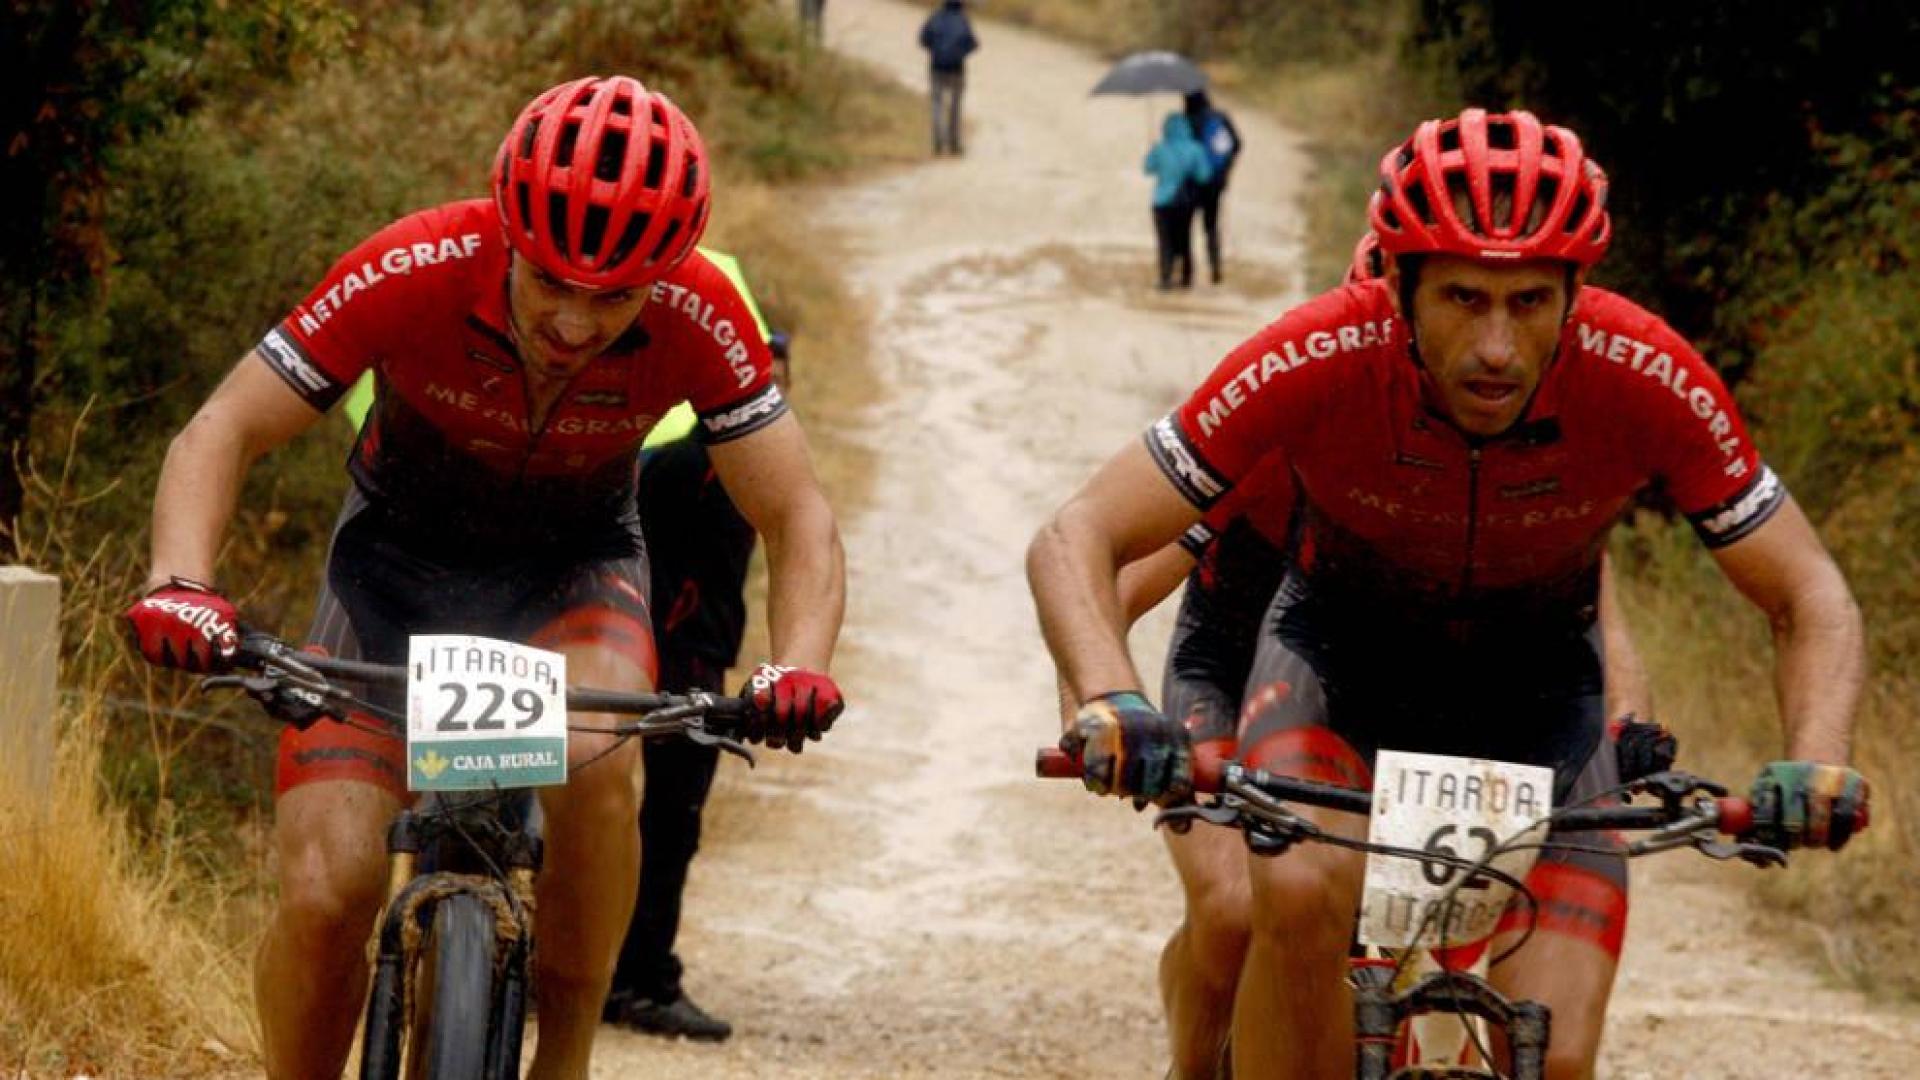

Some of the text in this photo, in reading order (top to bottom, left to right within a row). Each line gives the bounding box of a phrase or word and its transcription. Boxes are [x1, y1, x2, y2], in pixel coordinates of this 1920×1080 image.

[299, 233, 481, 336] METALGRAF
[651, 280, 757, 388] ETALGRA
[1197, 317, 1392, 438] METALGRAF
[430, 647, 551, 685] ITAROA
[437, 682, 544, 731] 229
[454, 752, 558, 770] CAJA RURAL
[1398, 769, 1534, 817] ITAROA
[1423, 824, 1498, 890] 62
